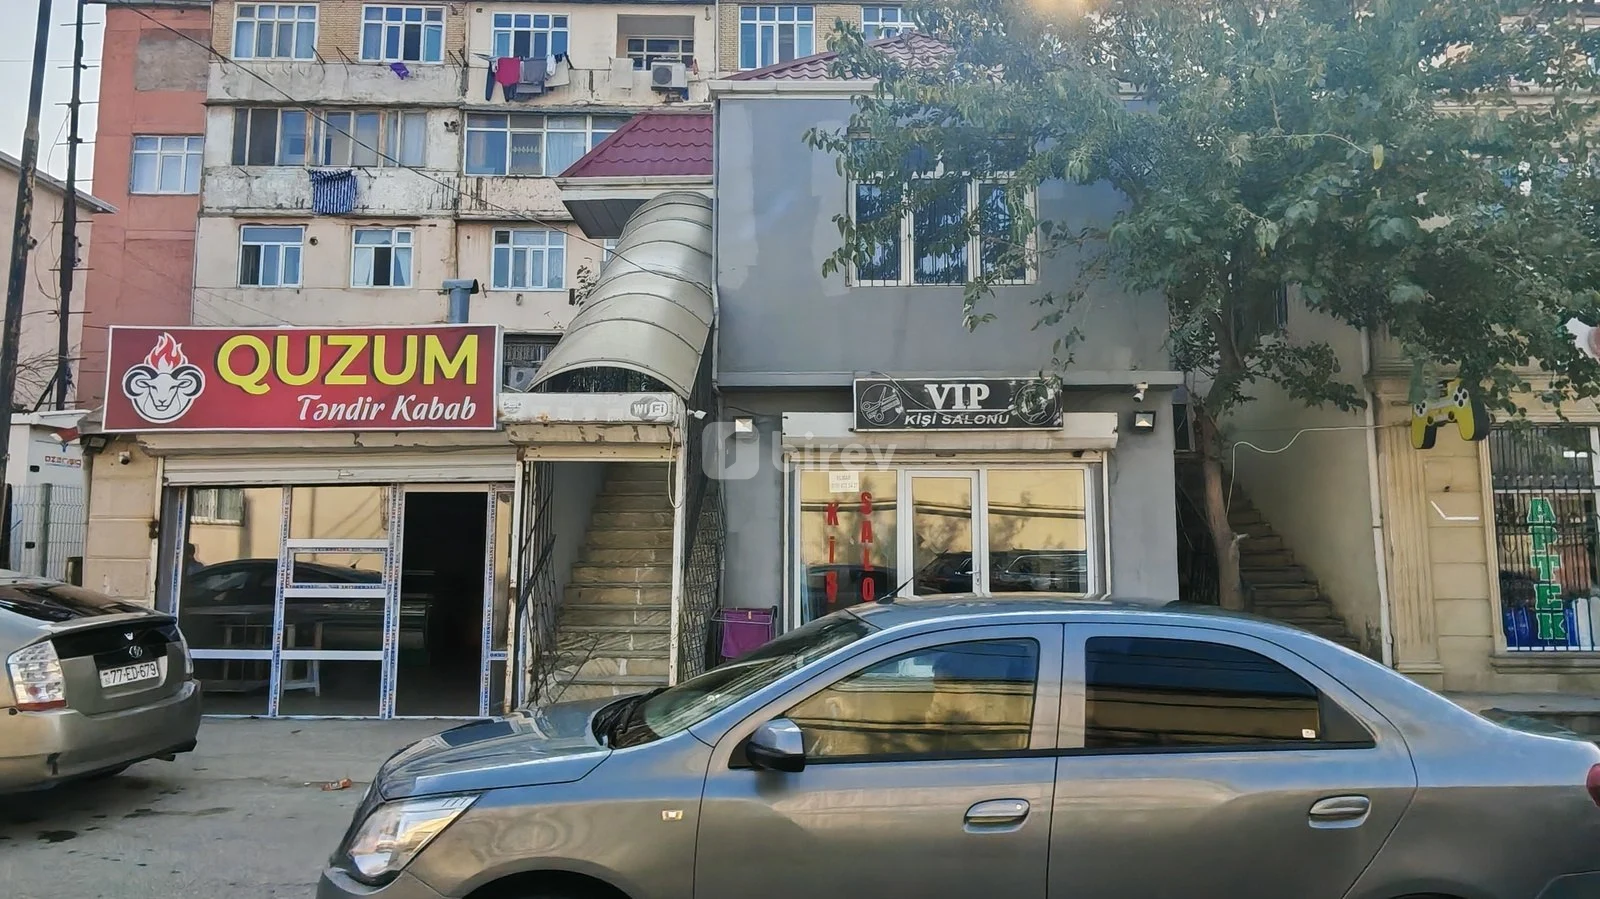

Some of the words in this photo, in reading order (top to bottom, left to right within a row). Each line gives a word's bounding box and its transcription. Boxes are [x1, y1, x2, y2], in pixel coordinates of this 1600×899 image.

[216, 334, 478, 395] QUZUM
[297, 394, 385, 421] Təndir
[391, 394, 476, 421] Kabab
[924, 383, 990, 410] VIP
[904, 412, 937, 427] KİŞİ
[941, 414, 1010, 426] SALONU
[1526, 496, 1567, 640] APTEK
[110, 662, 156, 684] 77-ED-679
